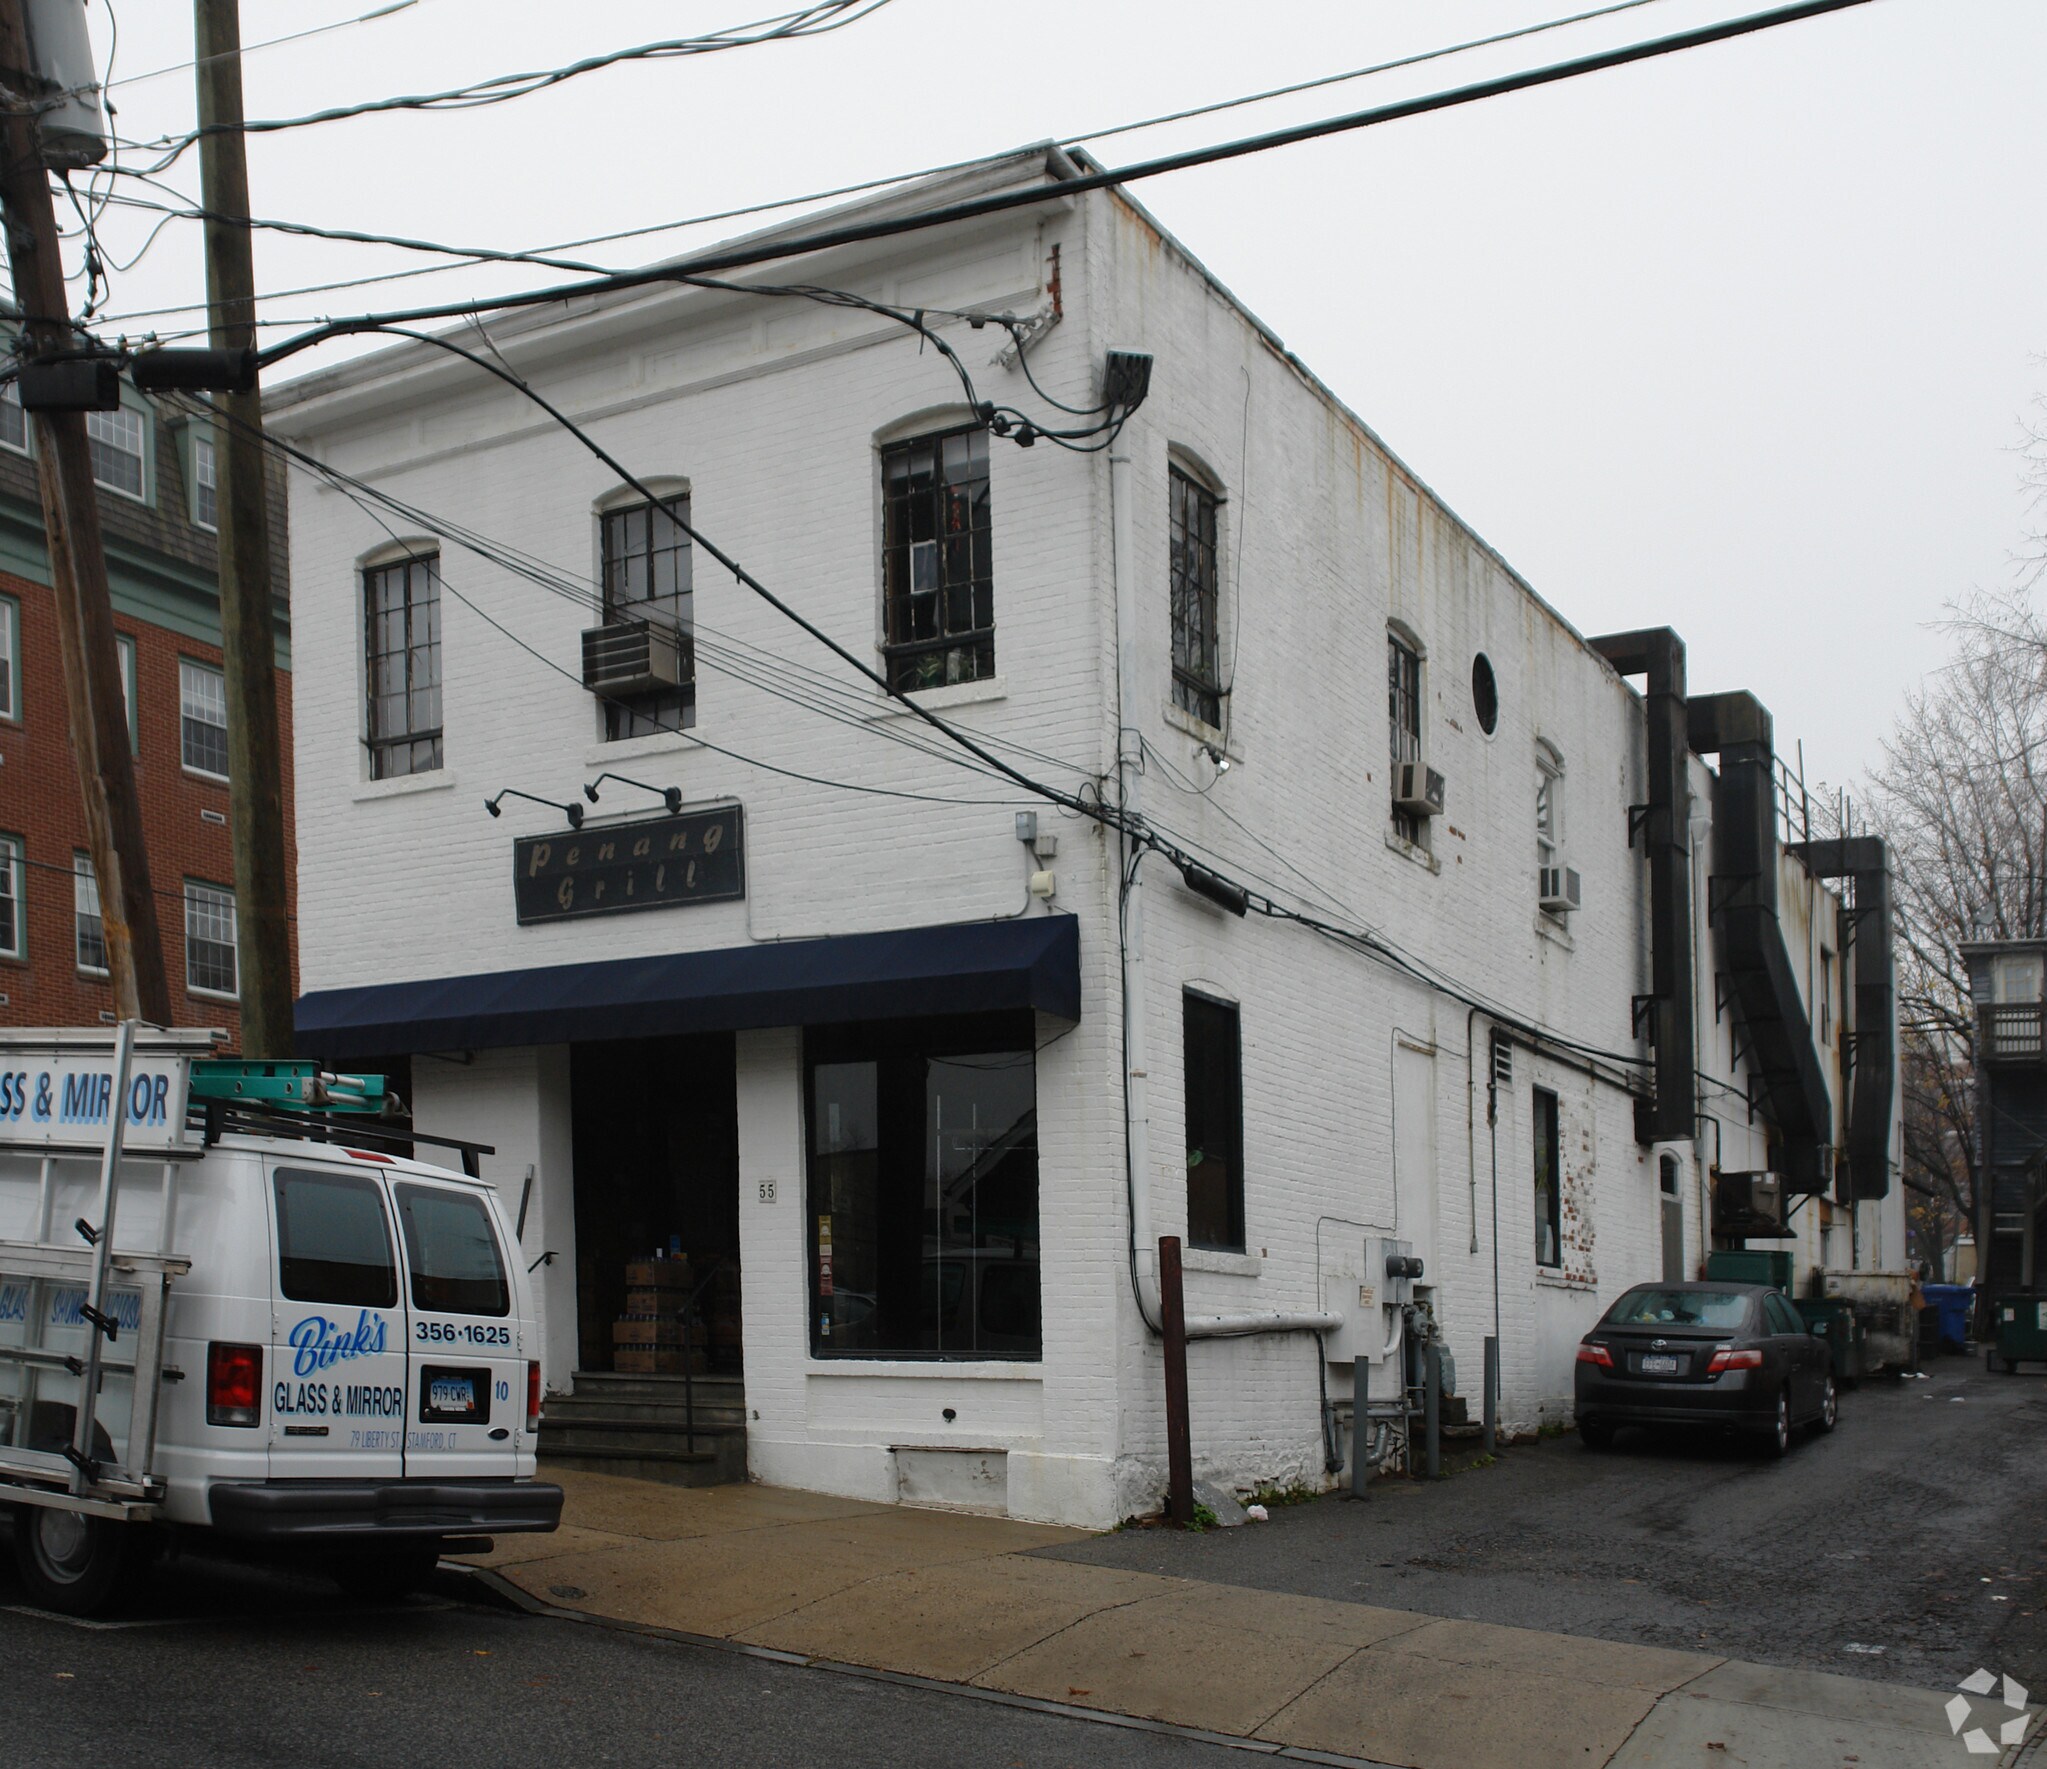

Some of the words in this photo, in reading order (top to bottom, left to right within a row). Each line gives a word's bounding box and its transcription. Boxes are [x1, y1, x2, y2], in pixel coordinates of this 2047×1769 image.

[558, 860, 696, 910] Grill
[32, 1071, 52, 1123] &
[59, 1072, 169, 1127] MIROR
[759, 1184, 774, 1199] 55
[274, 1382, 328, 1414] GLASS
[332, 1385, 342, 1414] &
[346, 1385, 403, 1416] MIRROR
[495, 1380, 509, 1401] 10
[350, 1430, 360, 1448] 79
[361, 1431, 389, 1448] LIBERTY
[448, 1432, 457, 1449] CT
